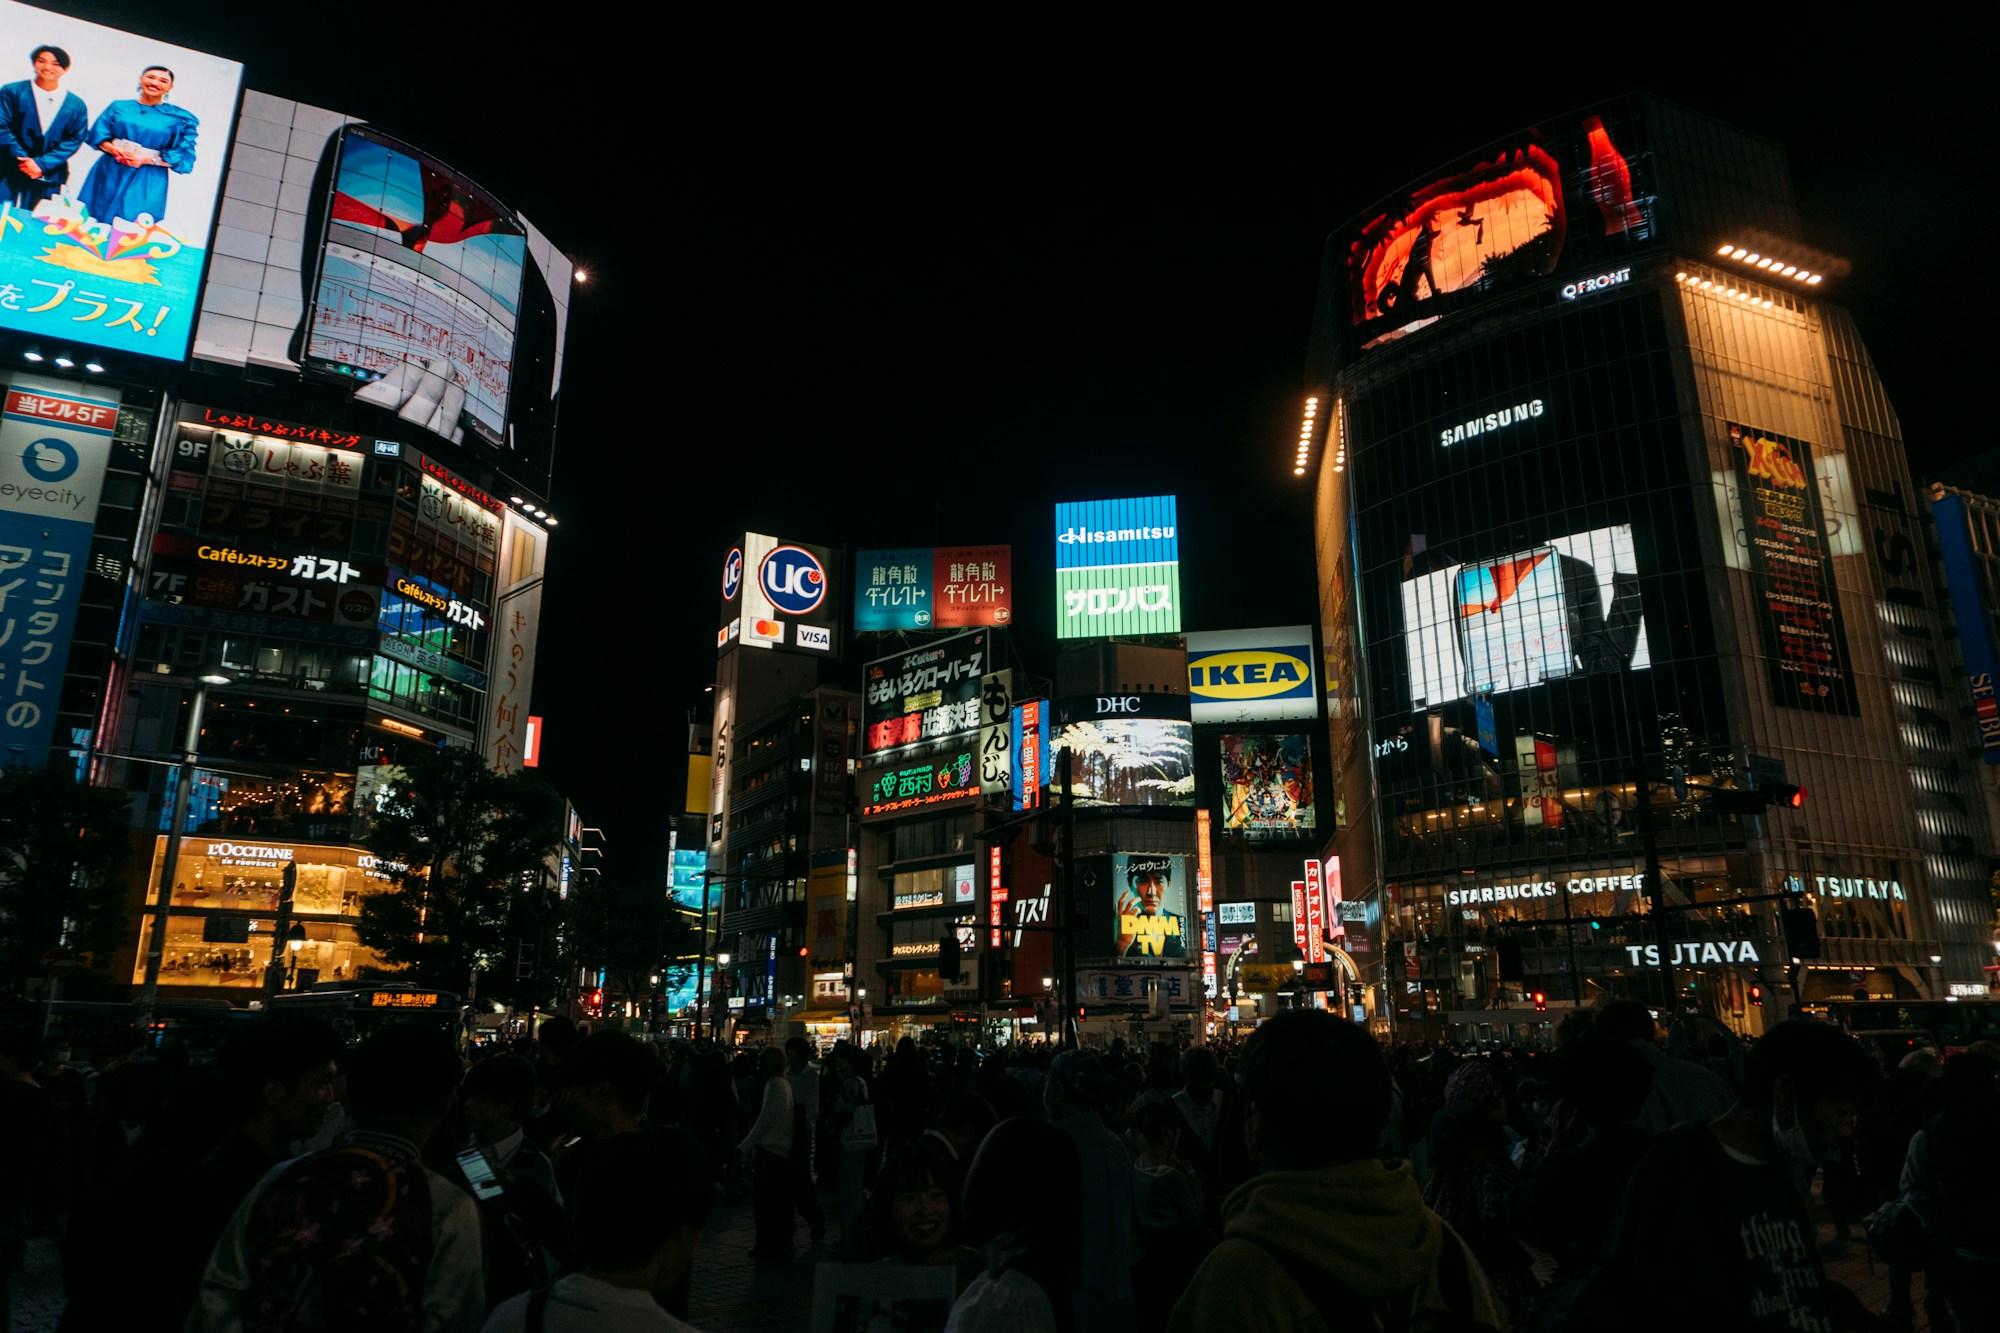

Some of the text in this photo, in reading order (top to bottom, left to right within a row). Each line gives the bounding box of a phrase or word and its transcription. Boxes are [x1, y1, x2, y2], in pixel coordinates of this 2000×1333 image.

[1561, 267, 1631, 300] QFRONT
[16, 395, 108, 423] 当ビル5F
[1440, 399, 1544, 447] SAMSUNG
[204, 408, 362, 448] しゃぶしゃぶバイキング
[178, 440, 208, 458] 9F
[265, 450, 351, 485] しゃぶ葉
[1, 483, 86, 511] eyecity
[1058, 526, 1175, 545] Hisamitsu
[152, 570, 188, 593] 7F
[290, 555, 361, 584] ガスト
[767, 560, 821, 598] UC
[872, 565, 918, 586] 龍角散
[950, 561, 997, 583] 龍角散
[237, 580, 328, 617] ガスト
[1064, 584, 1173, 617] サロンパス
[446, 599, 485, 631] ガスト
[5, 549, 72, 730] コンタクトの
[801, 630, 828, 644] VISA
[1190, 661, 1300, 687] IKEA
[1096, 696, 1141, 714] DHC
[983, 674, 1010, 788] もんじゃ
[899, 773, 932, 797] 西村
[207, 842, 294, 860] L'OCCITANE
[1307, 867, 1322, 920] カラオケ
[1449, 873, 1645, 905] STARBUCKS COFFEE
[1815, 876, 1909, 902] TSUTAYA
[1121, 914, 1181, 936] DMM
[1136, 934, 1166, 955] TV
[1625, 940, 1760, 967] TSUTAYA
